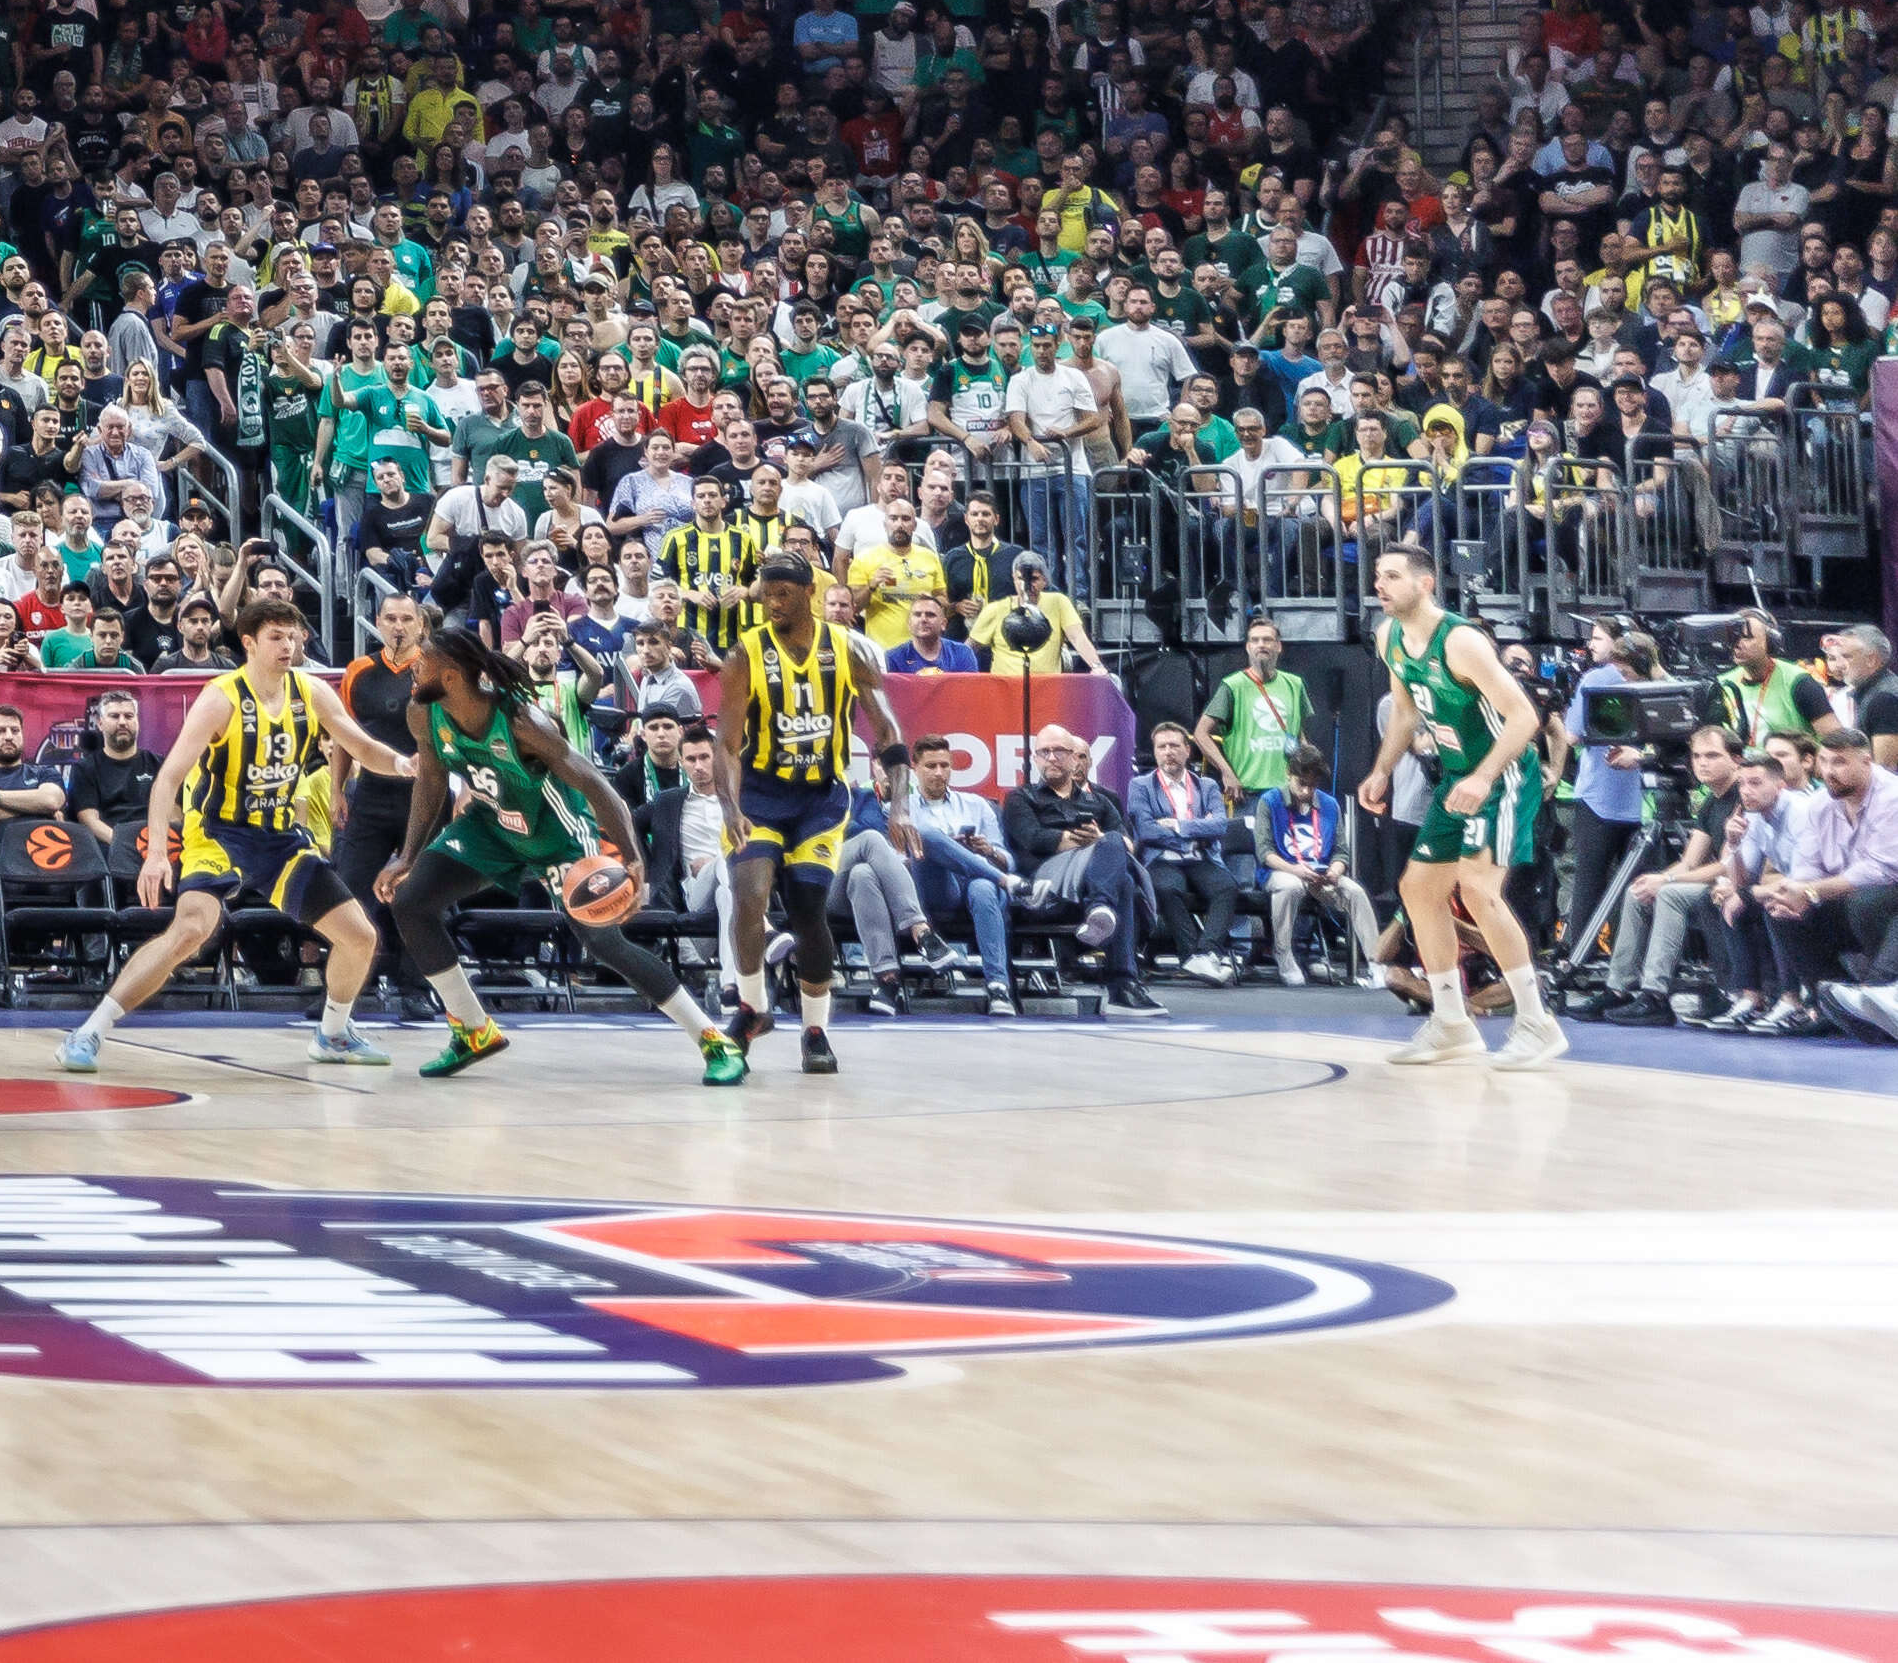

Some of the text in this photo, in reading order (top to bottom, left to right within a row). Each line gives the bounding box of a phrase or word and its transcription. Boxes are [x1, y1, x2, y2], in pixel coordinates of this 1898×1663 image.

[976, 393, 992, 410] 10
[693, 570, 735, 589] avea
[791, 681, 813, 710] 11
[1410, 682, 1435, 714] 21
[776, 711, 833, 736] beko
[261, 732, 292, 760] 13
[247, 761, 298, 781] beko
[1462, 819, 1487, 847] 21
